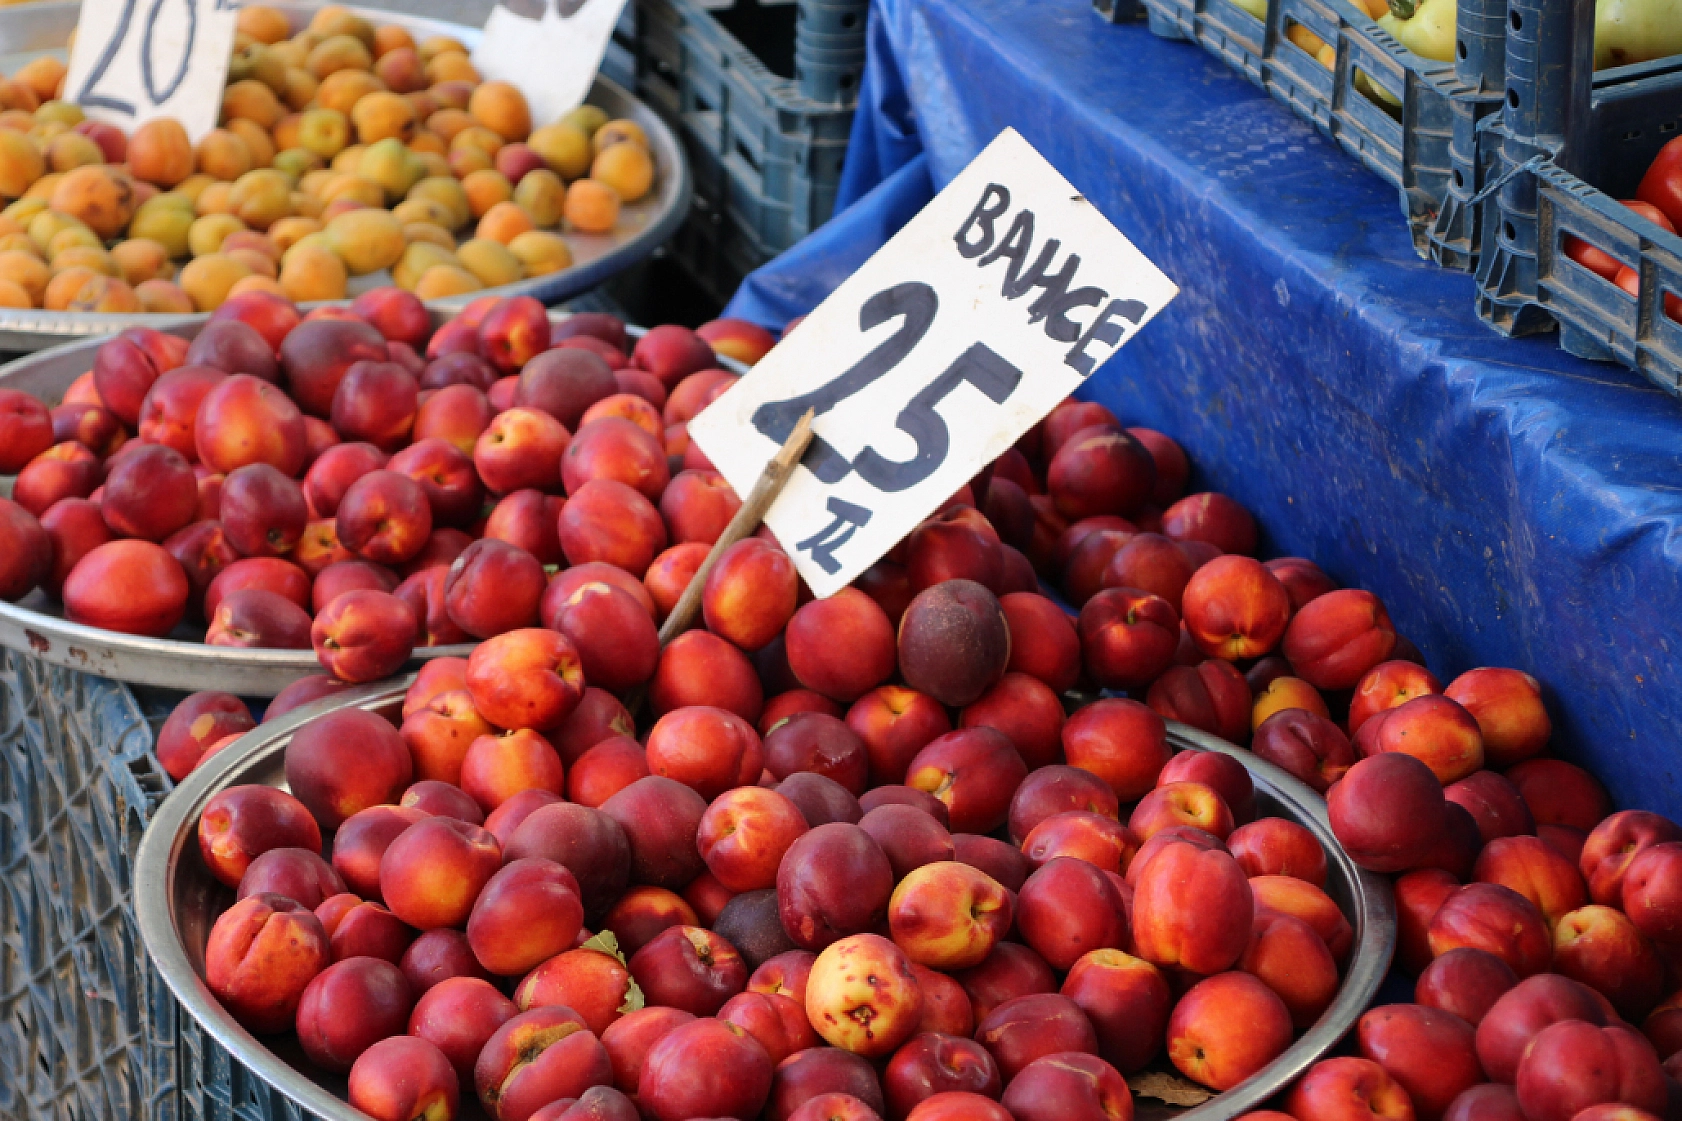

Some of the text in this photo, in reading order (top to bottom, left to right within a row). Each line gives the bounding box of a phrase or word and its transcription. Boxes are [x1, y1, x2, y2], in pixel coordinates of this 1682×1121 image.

[77, 0, 196, 116] 20
[751, 281, 1023, 492] 25
[796, 496, 873, 575] TL
